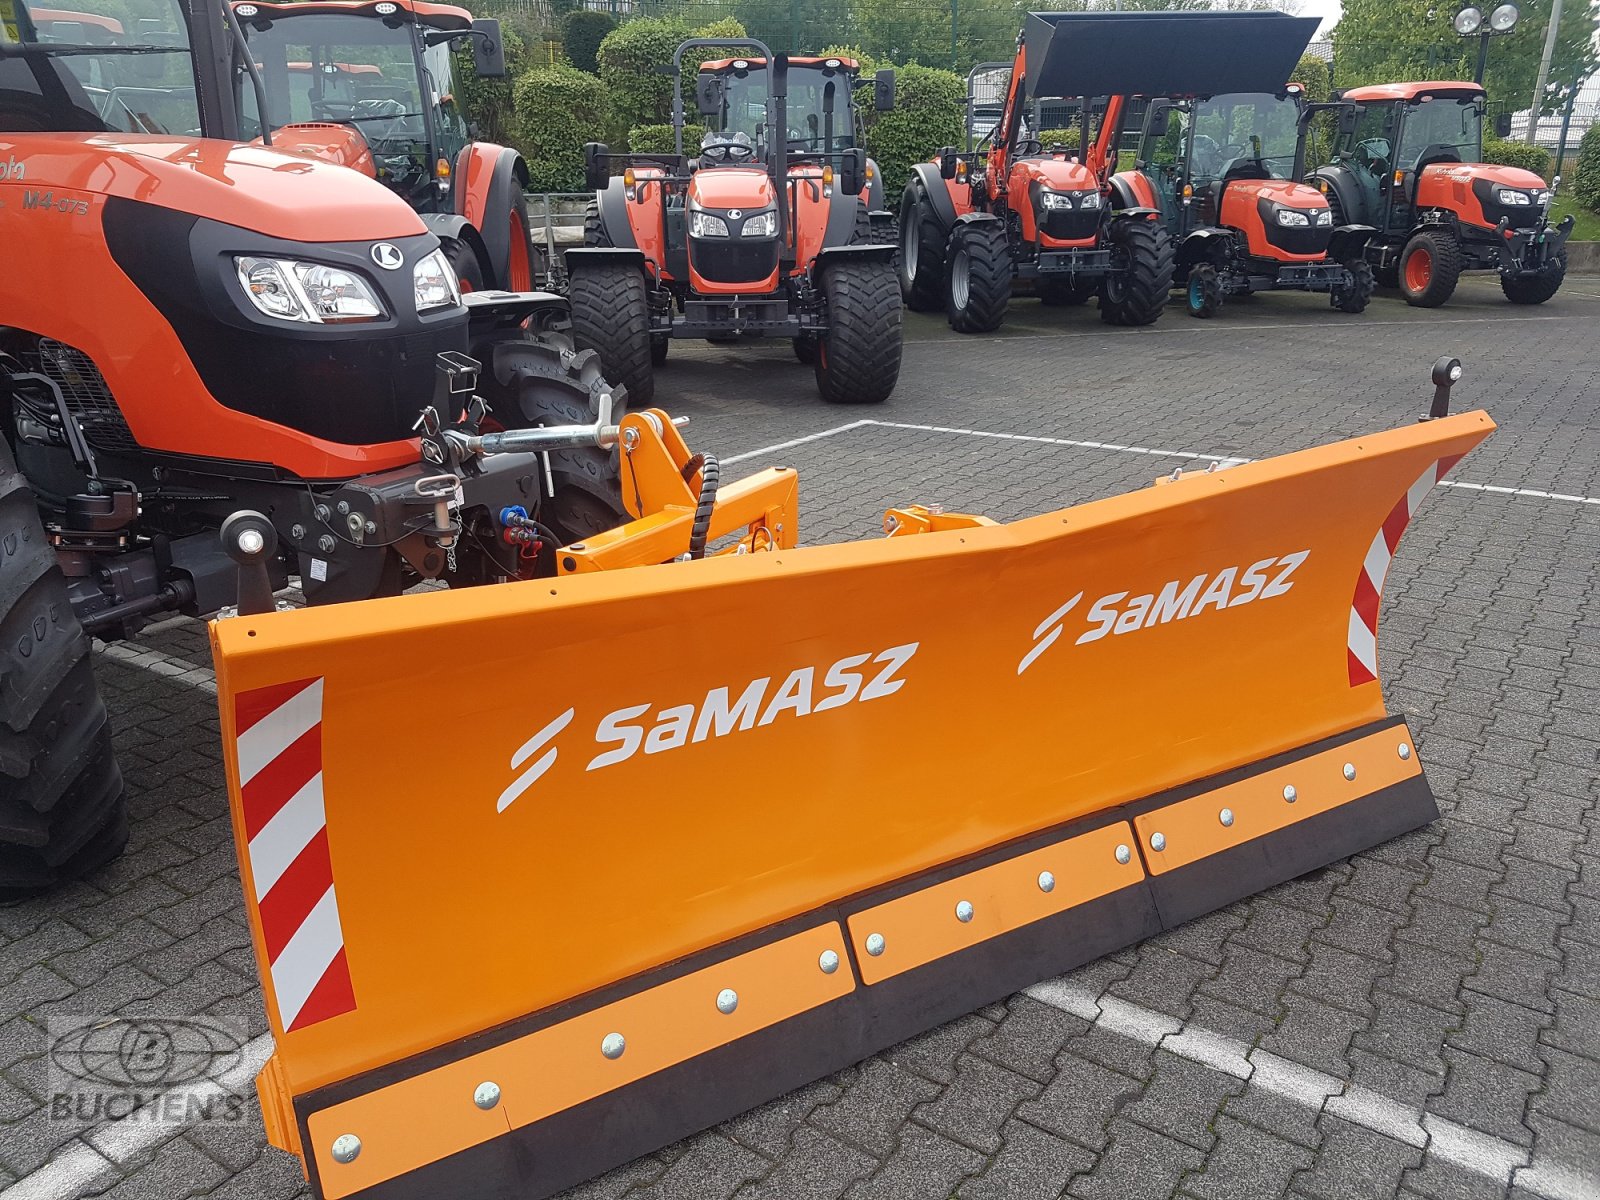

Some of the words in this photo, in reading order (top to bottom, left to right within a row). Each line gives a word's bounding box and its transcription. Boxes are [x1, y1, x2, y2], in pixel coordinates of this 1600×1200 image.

[22, 190, 89, 215] M4-073
[1074, 549, 1311, 646] SaMASZ
[585, 641, 920, 771] SaMASZ
